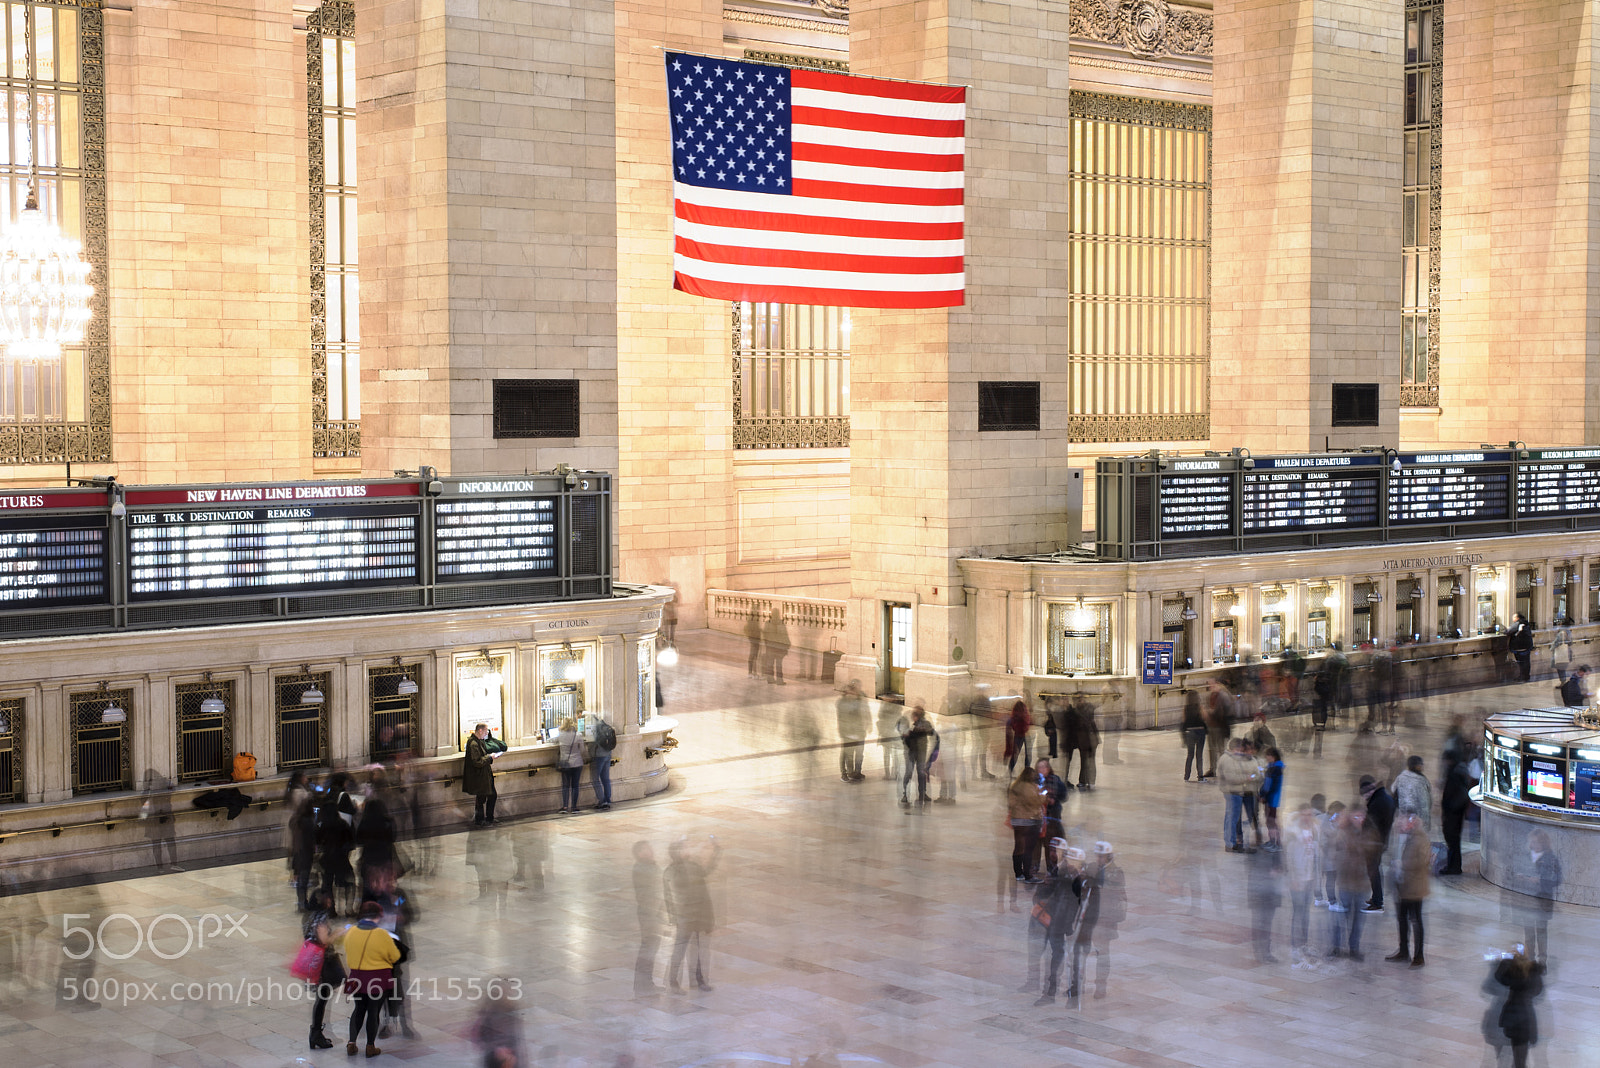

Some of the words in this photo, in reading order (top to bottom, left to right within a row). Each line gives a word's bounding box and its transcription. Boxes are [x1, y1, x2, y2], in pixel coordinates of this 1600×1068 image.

[1275, 459, 1300, 467] HARLEM
[1301, 458, 1314, 466] LINE
[1316, 457, 1350, 466] DEPARTURES
[1416, 455, 1438, 463] HARLEM
[1452, 453, 1484, 462] DEPARTURES
[1174, 461, 1219, 470] INFORMATION
[459, 481, 534, 493] INFORMATION
[187, 491, 217, 502] NEW
[220, 489, 262, 501] HAVEN
[265, 488, 293, 499] LINE
[295, 486, 367, 499] DEPARTURES
[0, 495, 44, 508] TURES
[132, 514, 156, 523] TIME
[163, 513, 184, 522] TRK
[190, 510, 254, 521] DESTINATION
[267, 508, 312, 518] REMARKS
[17, 533, 37, 543] STOP
[522, 549, 546, 557] DETAILS
[17, 561, 38, 571] STOP
[1383, 560, 1399, 570] MTA
[1400, 555, 1453, 569] METRO-NORTH
[1455, 553, 1483, 564] TICKETS
[18, 589, 38, 599] STOP
[548, 620, 563, 629] GCT
[566, 618, 589, 628] TOURS
